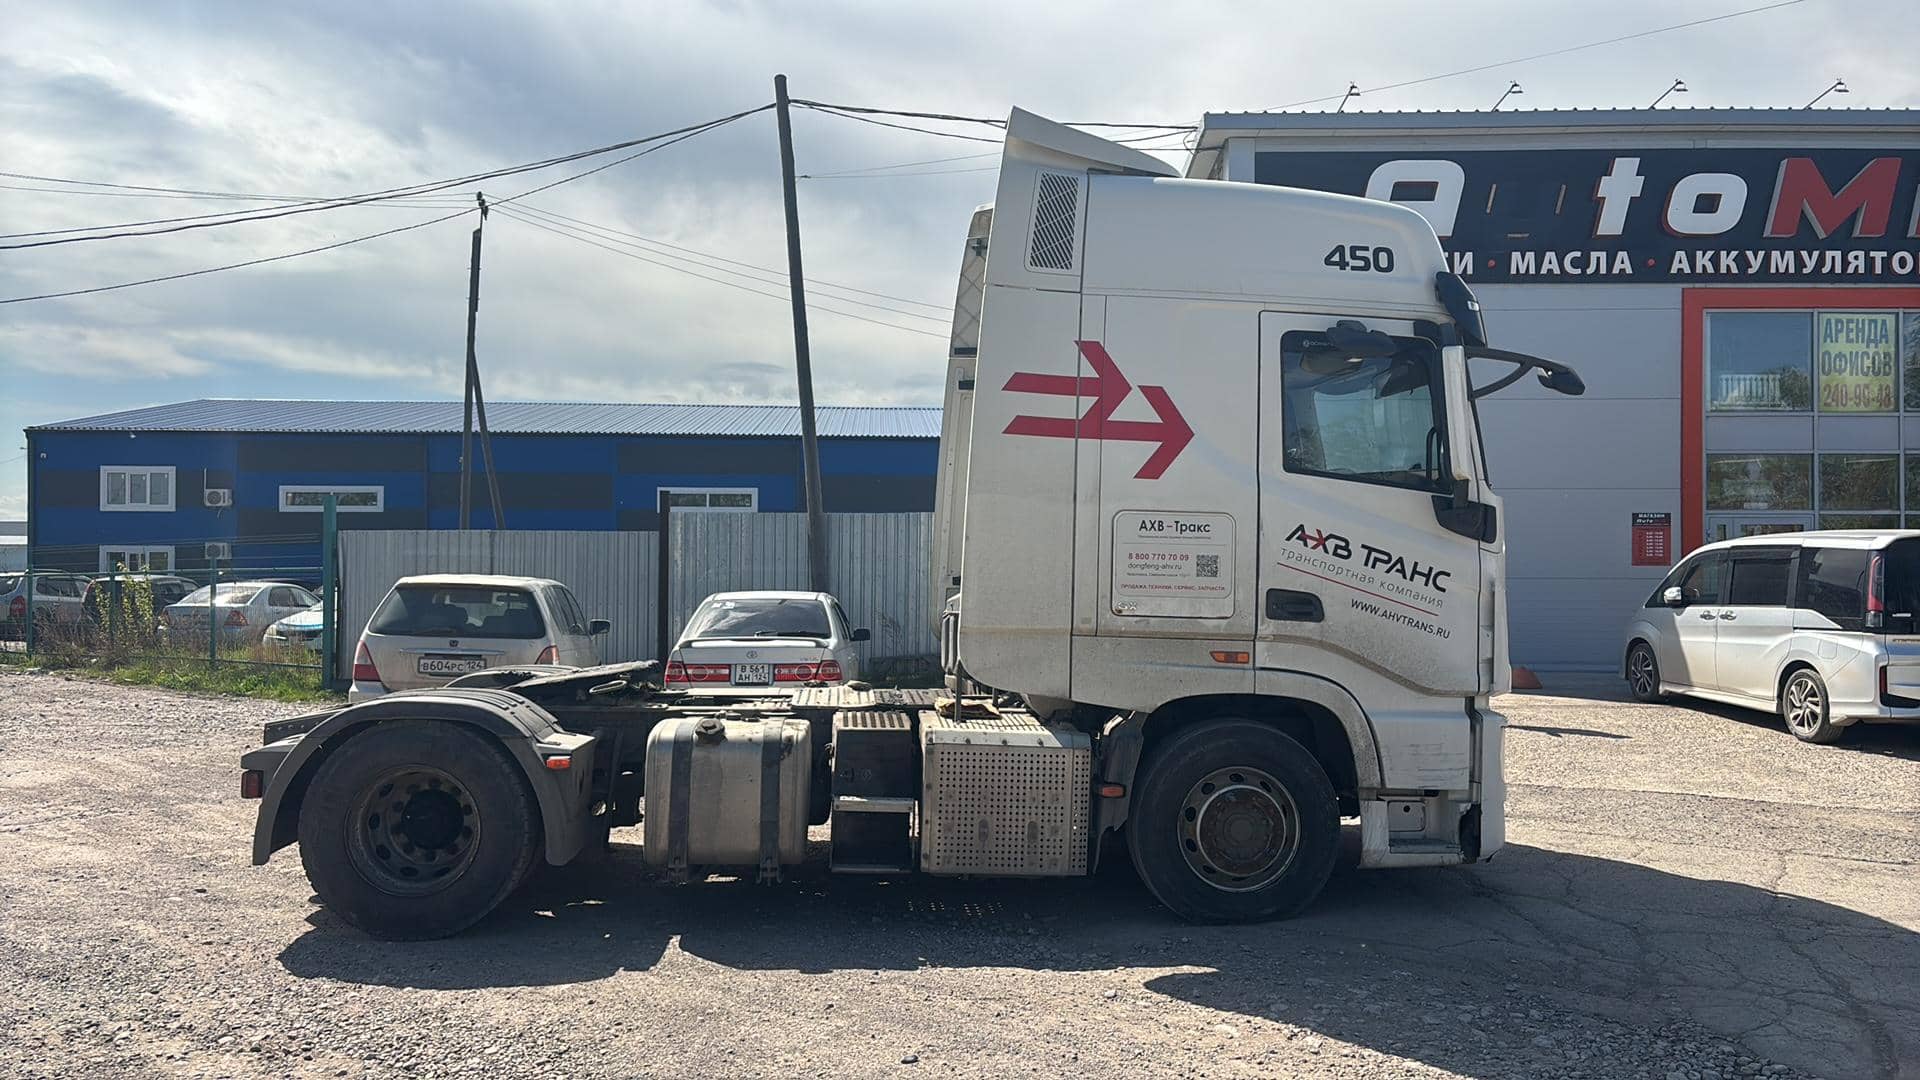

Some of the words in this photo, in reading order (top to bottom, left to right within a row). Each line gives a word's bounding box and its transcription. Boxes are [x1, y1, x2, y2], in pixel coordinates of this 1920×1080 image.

[1324, 244, 1394, 273] 450
[1509, 250, 1633, 275] МАСЛА
[1669, 249, 1920, 275] АККУМУЛЯТО
[1823, 318, 1889, 348] АРЕНДА
[1821, 350, 1892, 377] ОФИСОВ
[1135, 552, 1149, 560] 800
[1168, 553, 1178, 561] 70
[1361, 543, 1451, 593] ТРАНС
[1281, 547, 1375, 585] транспортная
[1379, 580, 1443, 609] компания
[1351, 598, 1451, 639] WWW.AHVTRANS.RU
